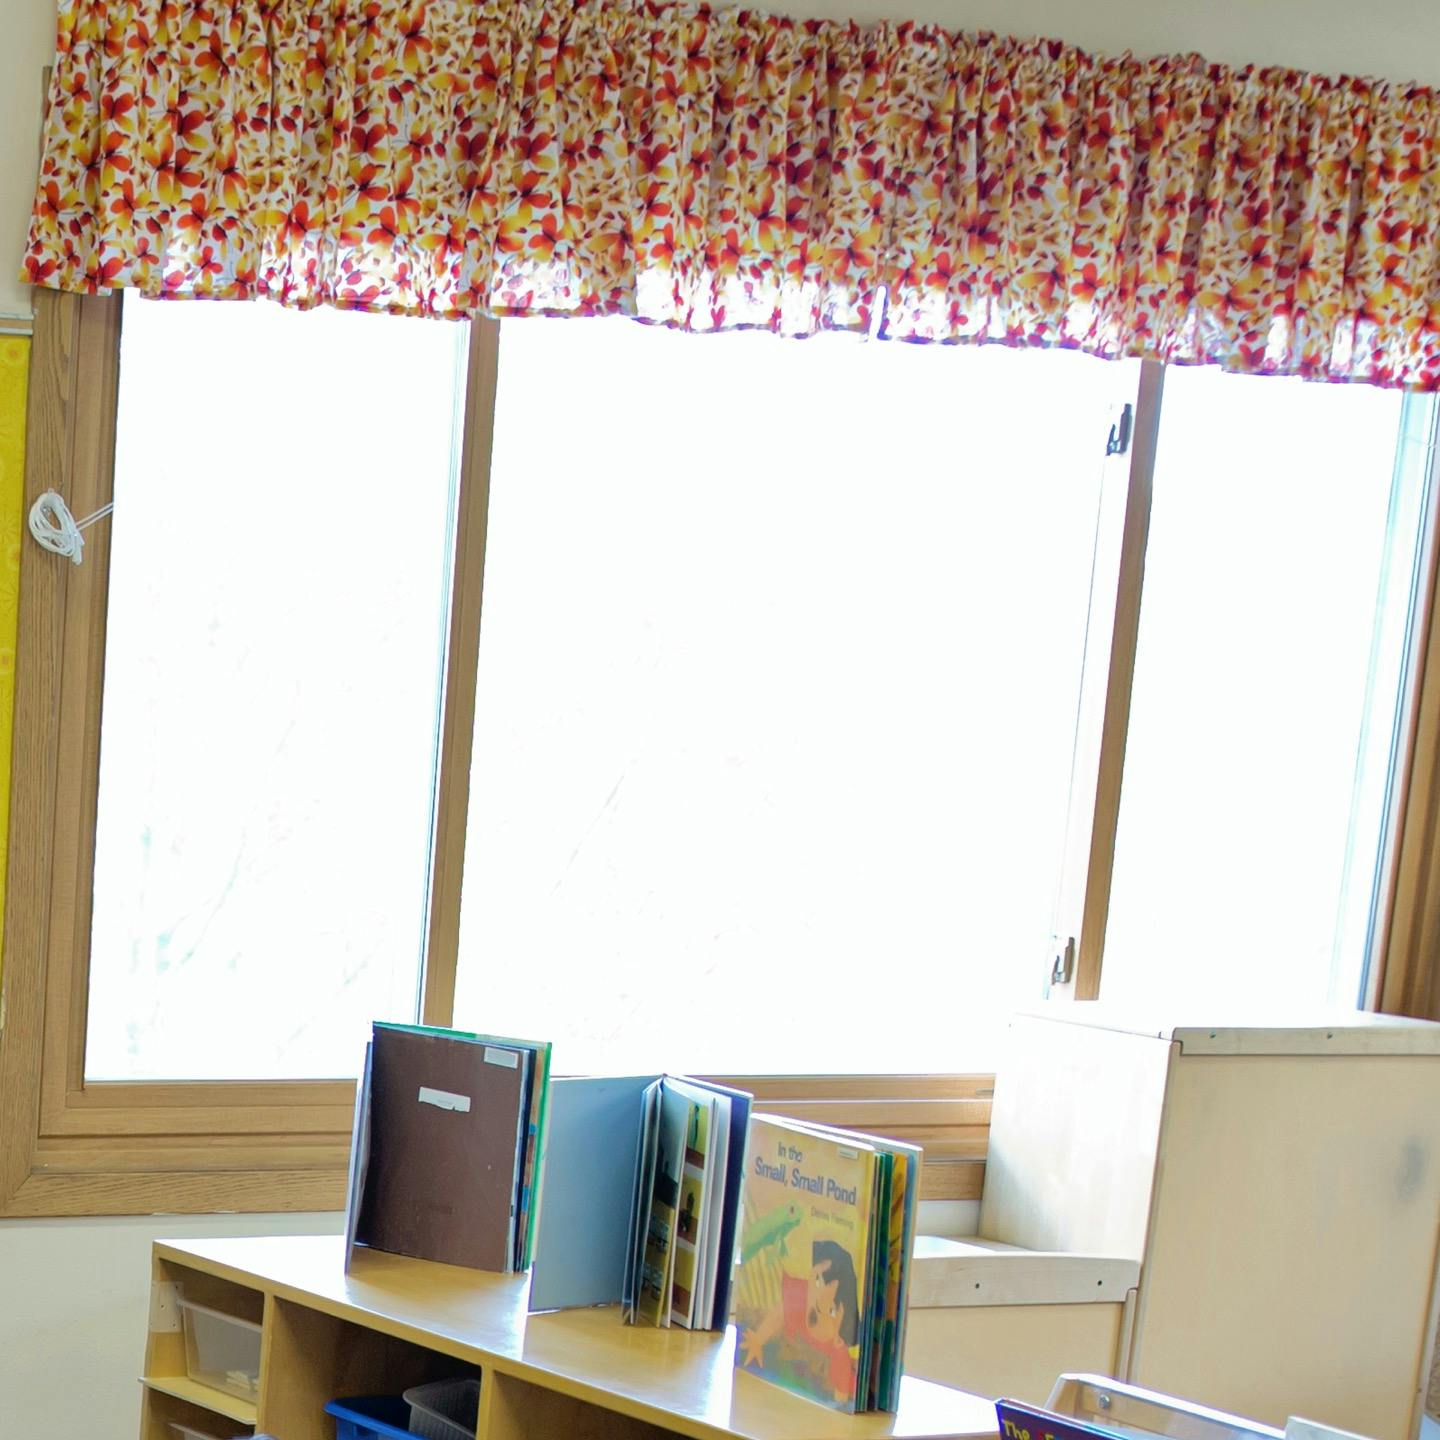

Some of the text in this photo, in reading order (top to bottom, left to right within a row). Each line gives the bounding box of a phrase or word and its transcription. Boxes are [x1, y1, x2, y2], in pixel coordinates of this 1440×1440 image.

[778, 1141, 804, 1163] In the
[755, 1156, 858, 1206] Small, Small Pond
